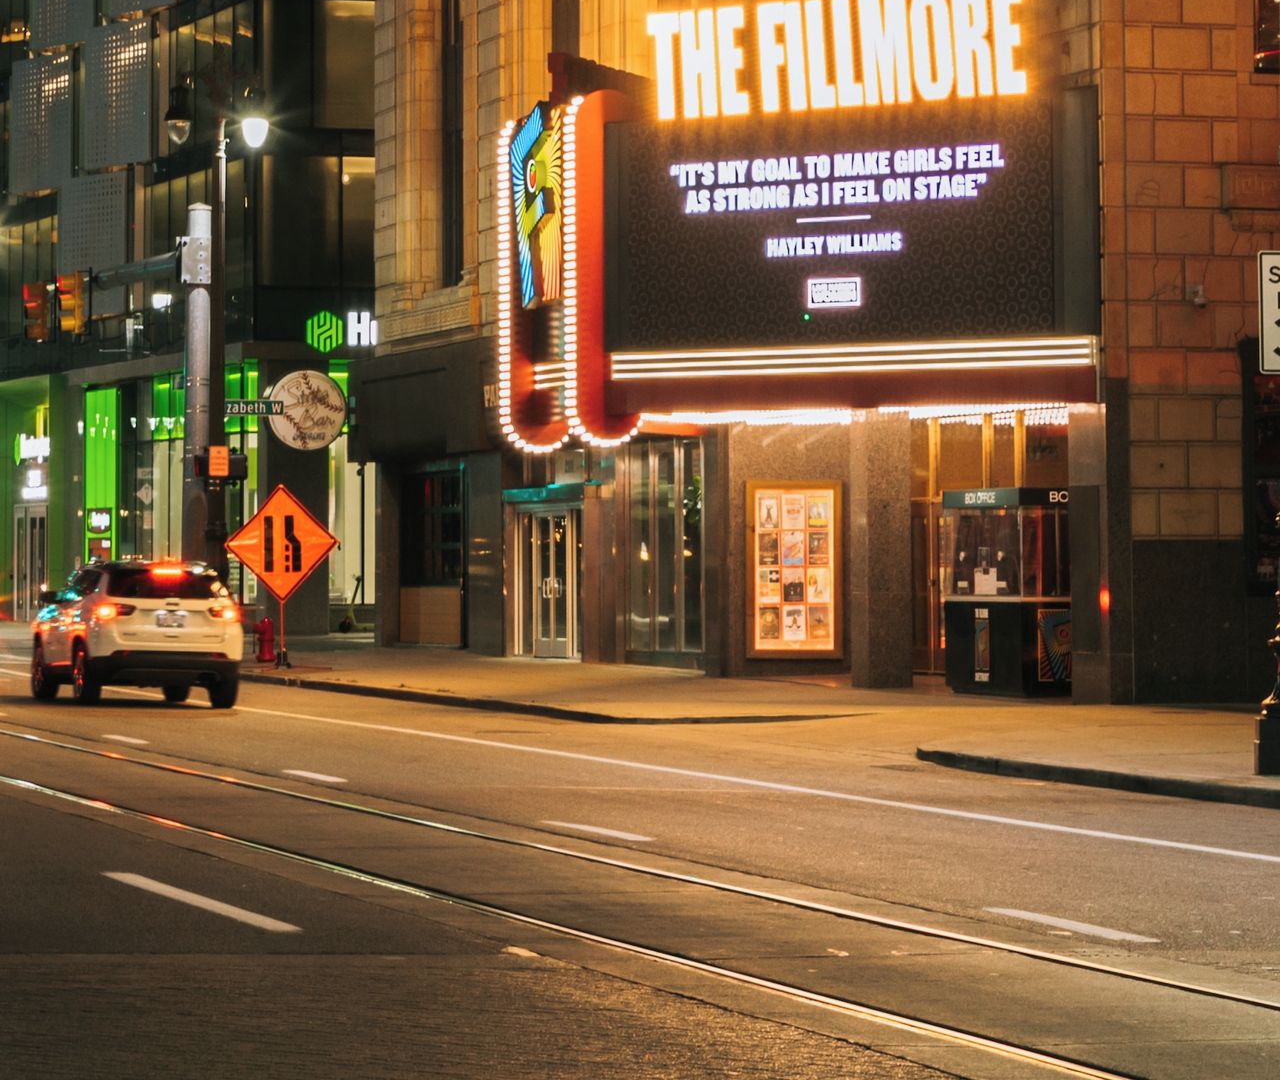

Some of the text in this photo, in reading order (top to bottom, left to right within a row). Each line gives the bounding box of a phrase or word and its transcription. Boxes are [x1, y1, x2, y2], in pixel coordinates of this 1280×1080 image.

[646, 5, 750, 121] THE
[718, 160, 750, 185] MY
[751, 156, 802, 182] GOAL
[804, 155, 832, 179] TO
[834, 151, 892, 177] MAKE
[893, 148, 953, 173] GIRLS
[956, 144, 1005, 170] FEEL
[685, 190, 711, 214] AS
[713, 185, 790, 212] STRONG
[793, 183, 819, 208] AS
[821, 182, 830, 205] I
[833, 179, 880, 205] FEEL
[882, 177, 912, 202] ON
[766, 231, 903, 257] HAYLEY WILLIAMS
[226, 402, 282, 414] zabeth W
[964, 491, 996, 504] BOX OFFICE
[1049, 490, 1069, 503] BO
